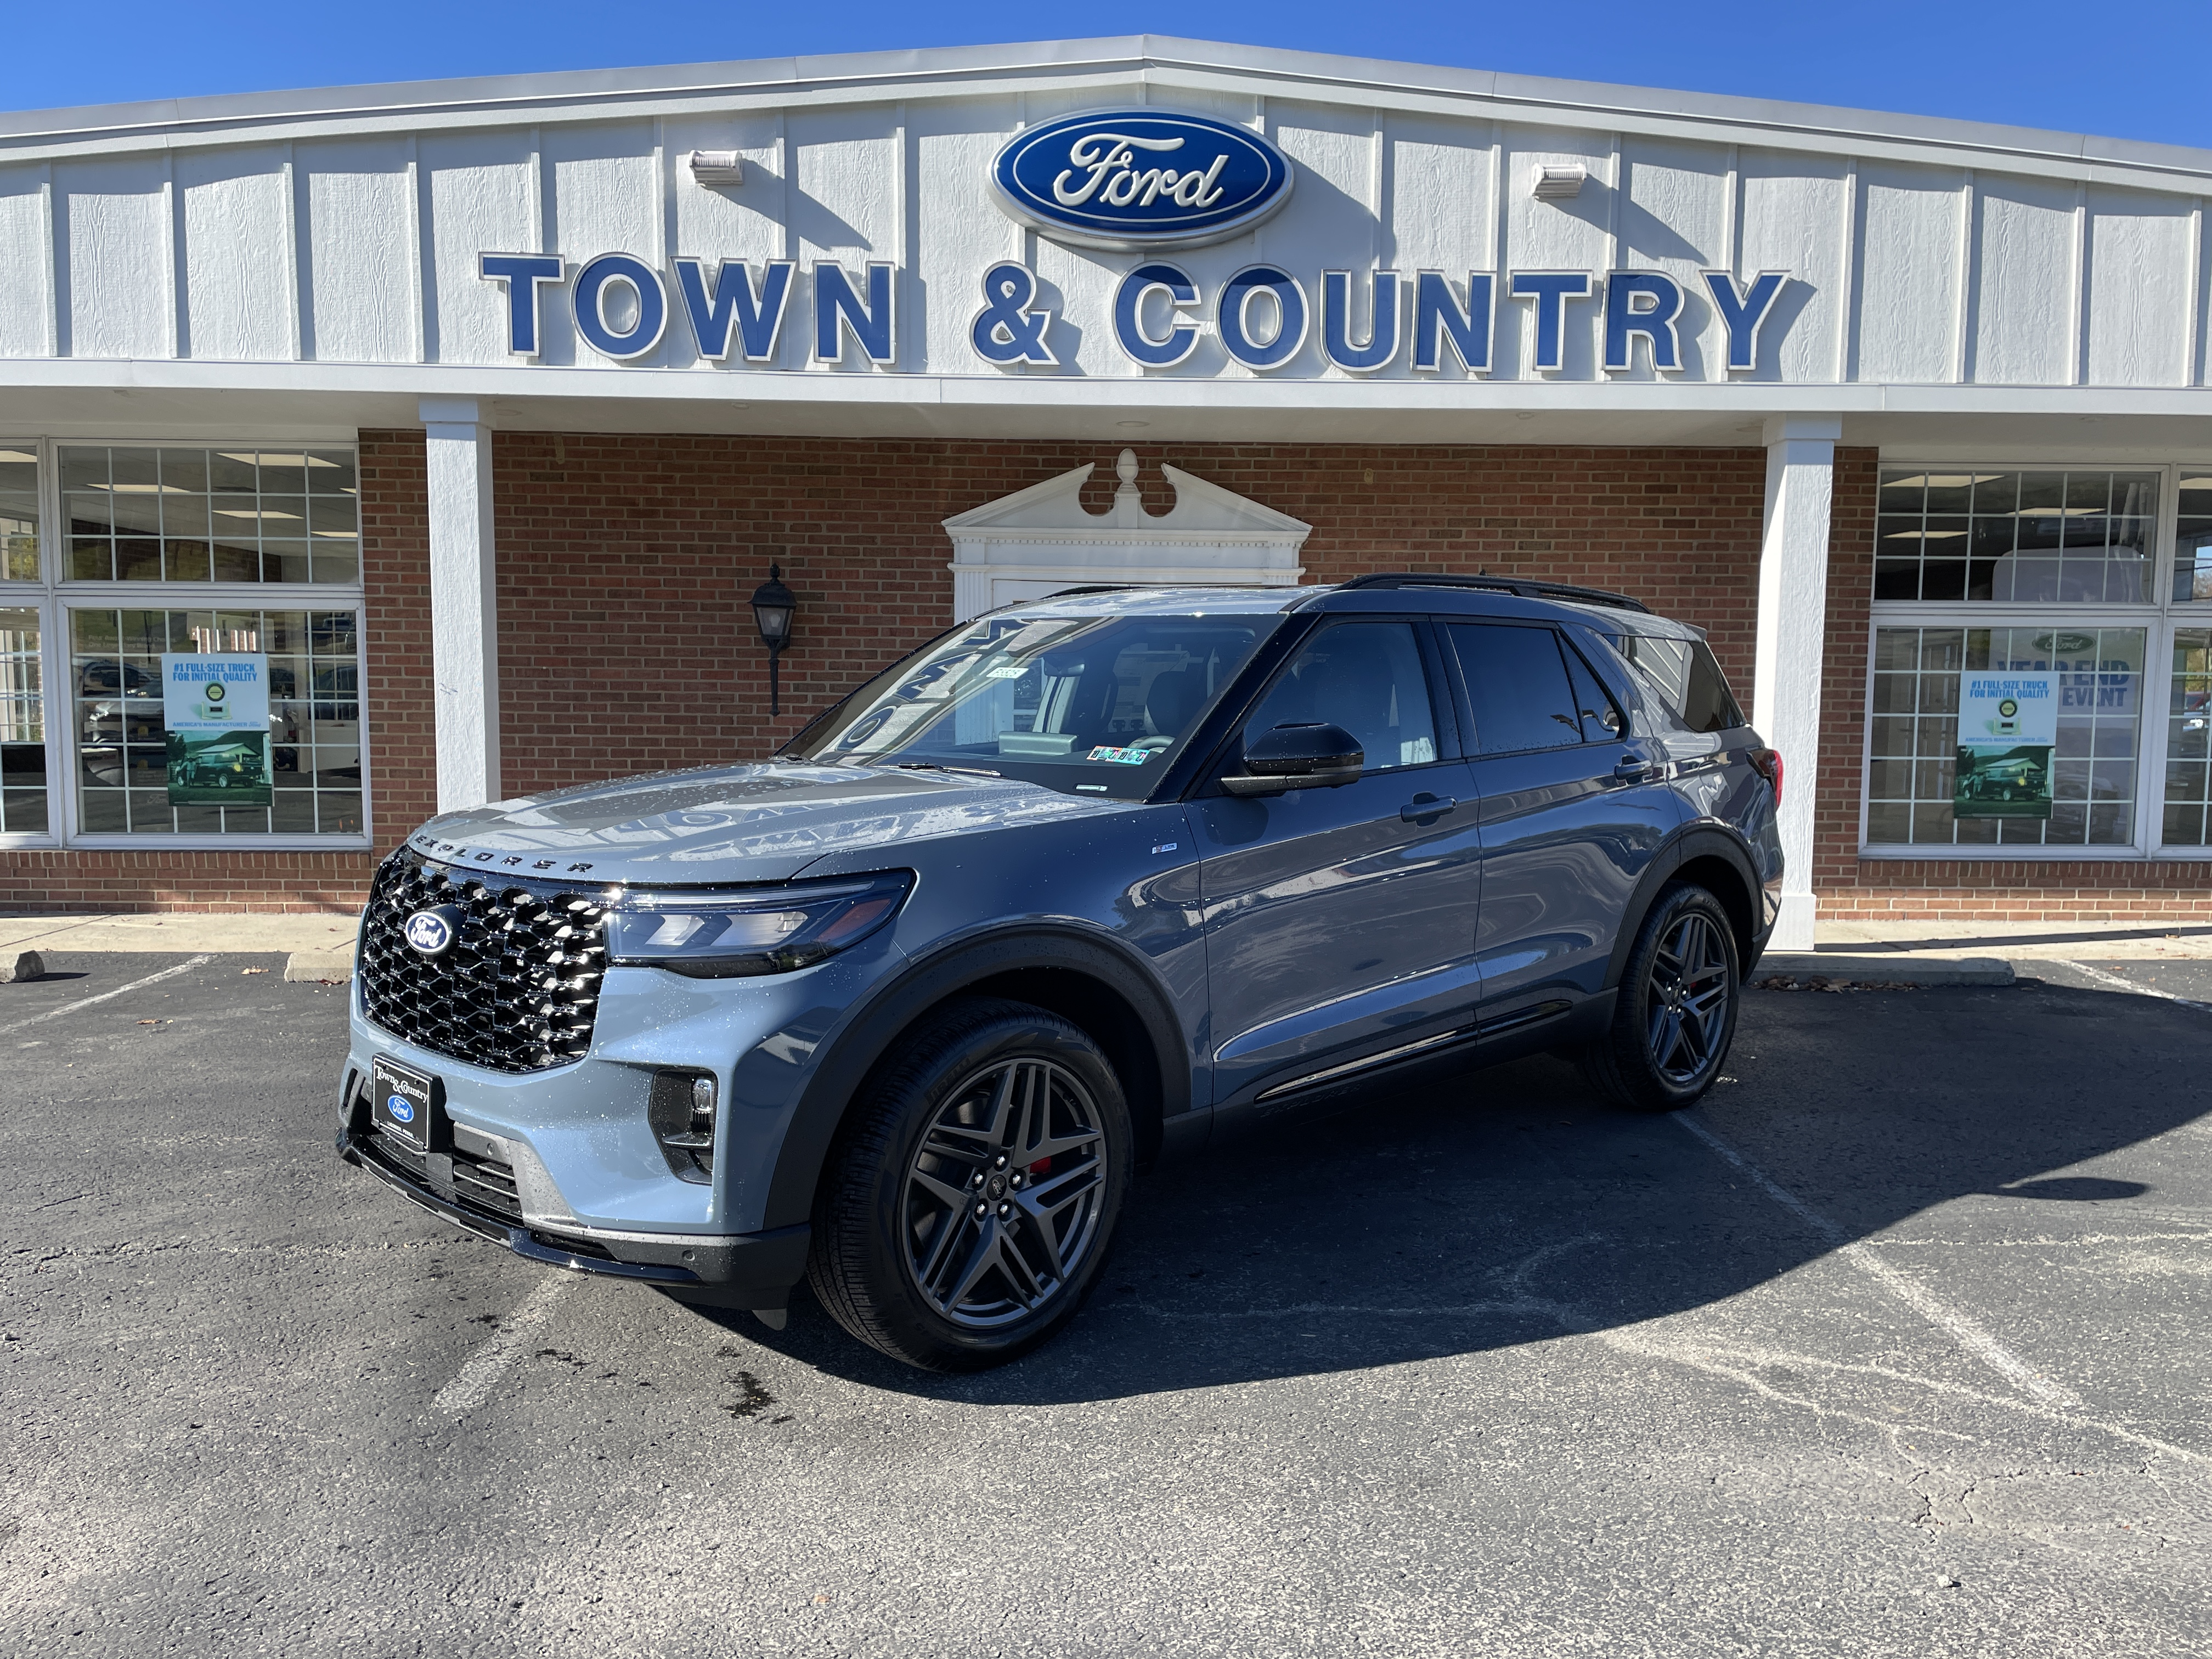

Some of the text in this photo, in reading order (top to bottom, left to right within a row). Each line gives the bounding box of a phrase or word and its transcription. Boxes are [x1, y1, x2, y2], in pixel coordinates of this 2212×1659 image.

[1053, 133, 1229, 208] Ford
[478, 252, 1792, 374] TOWN & COUNTRY
[2045, 636, 2083, 650] Ford
[174, 663, 255, 672] #1 FULL-SIZE TRUCK
[2074, 660, 2130, 685] END
[173, 673, 257, 684] FOR INITIAL QUALITY
[1971, 680, 2047, 689] #1 FULL-SIZE TRUCK
[1970, 689, 2050, 700] FOR INITIAL QUALITY
[2062, 687, 2128, 706] EVENT
[414, 834, 594, 873] EXPLORER
[411, 916, 442, 948] Ford
[375, 1065, 428, 1104] Town & Country
[392, 1098, 409, 1119] Ford
